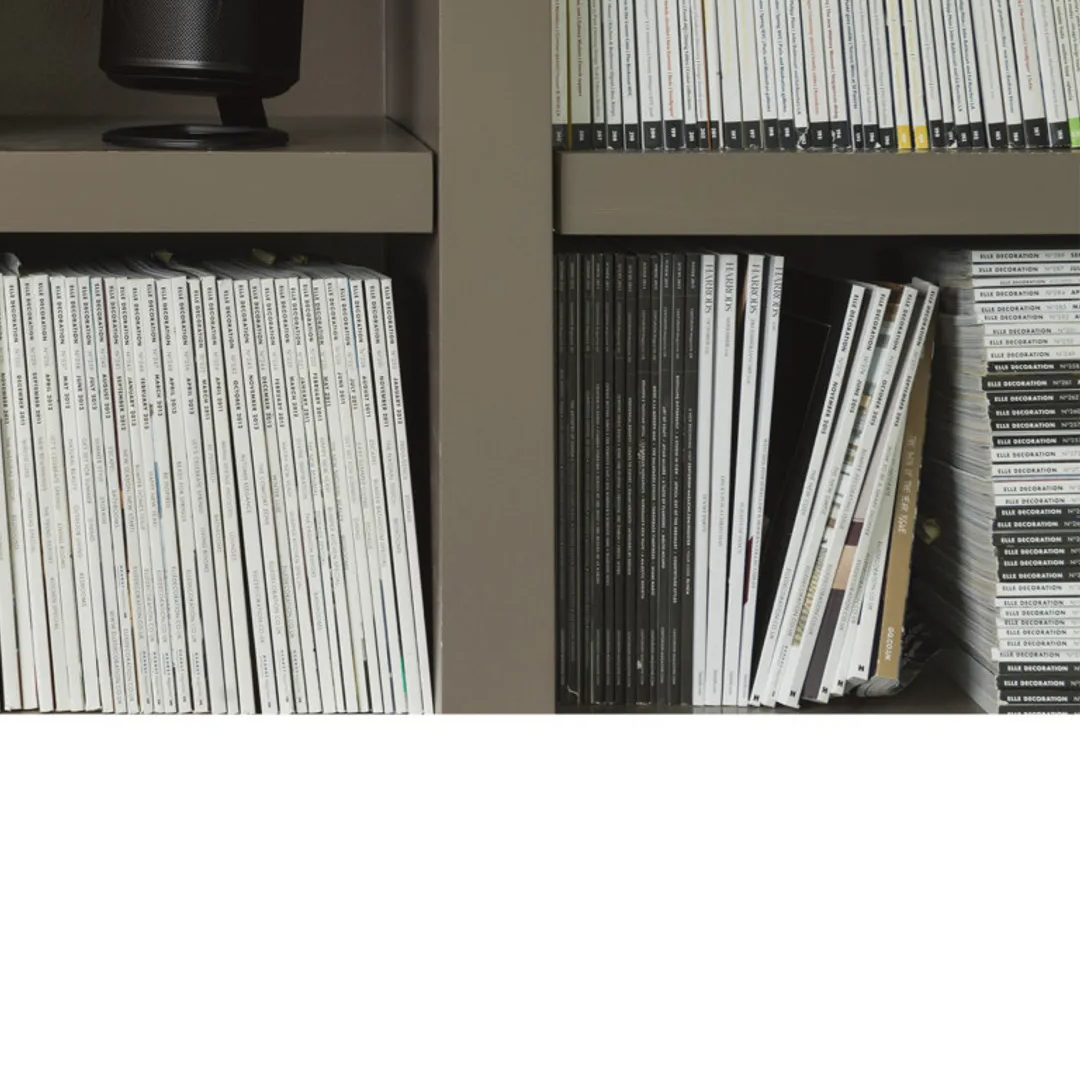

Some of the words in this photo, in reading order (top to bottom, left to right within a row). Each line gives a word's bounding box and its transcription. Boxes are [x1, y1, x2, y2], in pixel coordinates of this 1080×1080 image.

[705, 265, 714, 314] HARRODS
[724, 262, 734, 312] HARRODS
[750, 265, 760, 314] HARRODS
[772, 267, 783, 317] HARRODS
[851, 294, 859, 308] ELLE
[878, 294, 886, 307] ELLE
[841, 310, 857, 352] DECORATION
[866, 309, 882, 350] DECORATION
[892, 310, 908, 350] DECORATION
